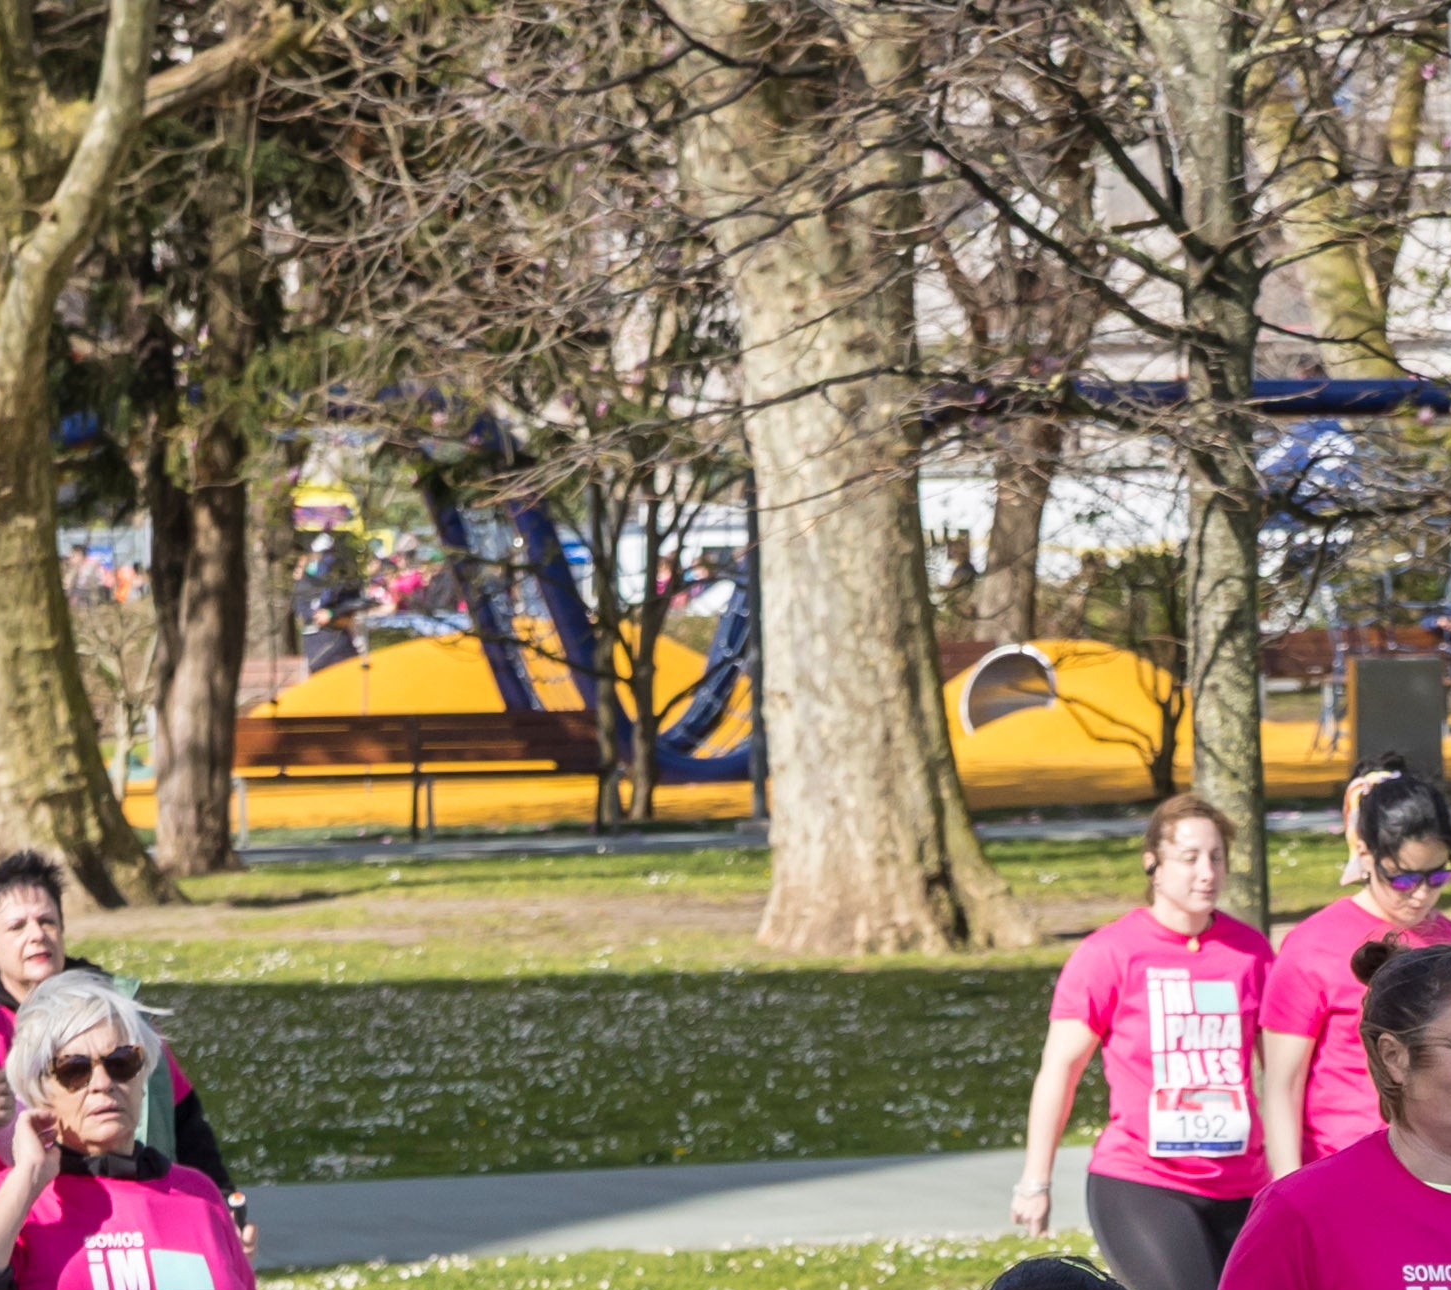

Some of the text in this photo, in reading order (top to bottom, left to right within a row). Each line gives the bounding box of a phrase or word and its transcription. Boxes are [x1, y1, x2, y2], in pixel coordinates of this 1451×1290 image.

[1166, 1014, 1242, 1050] PARA
[1167, 1050, 1243, 1085] BLES
[85, 1232, 144, 1249] SOMOS
